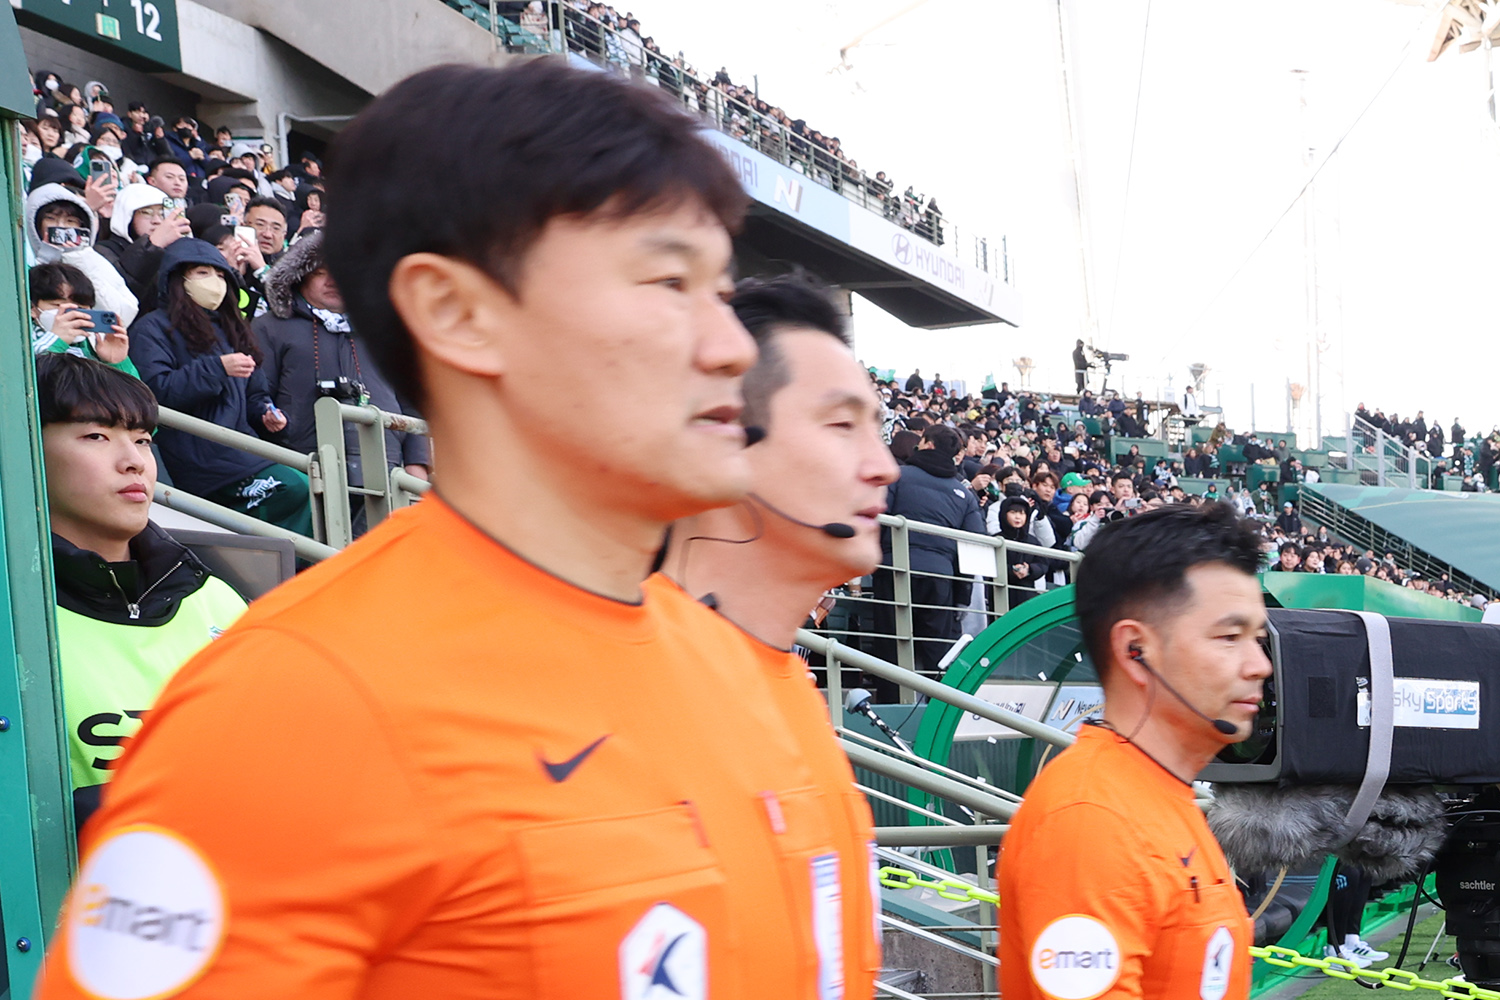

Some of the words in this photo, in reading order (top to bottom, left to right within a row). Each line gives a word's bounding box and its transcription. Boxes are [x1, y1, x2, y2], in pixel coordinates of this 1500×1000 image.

[131, 0, 163, 42] 12
[914, 245, 965, 290] HYUNDAI
[1393, 688, 1422, 712] sky
[1426, 688, 1477, 714] Sports
[1459, 880, 1496, 891] sachtler
[81, 885, 208, 951] emart
[1039, 948, 1114, 970] emart
